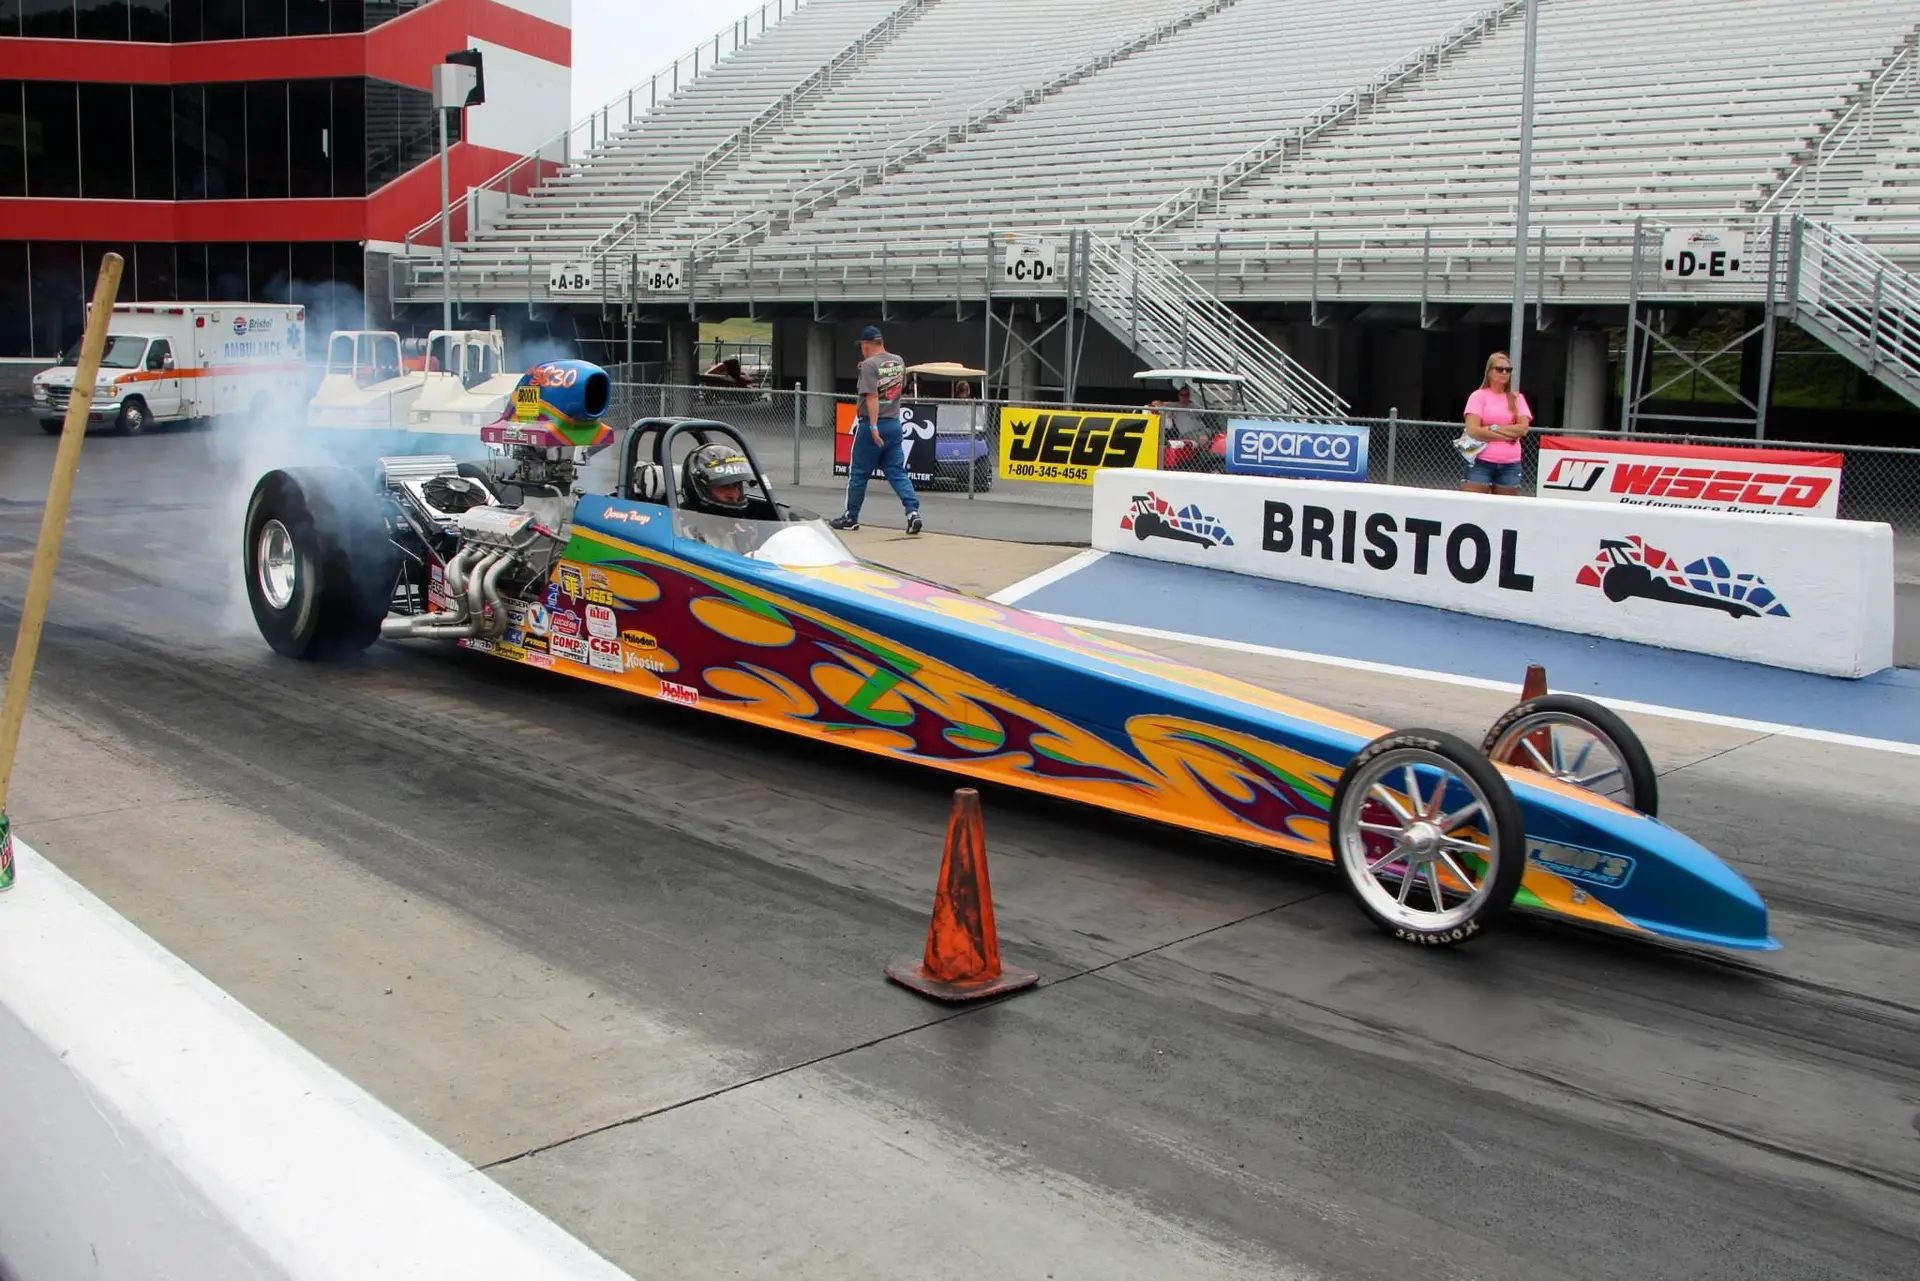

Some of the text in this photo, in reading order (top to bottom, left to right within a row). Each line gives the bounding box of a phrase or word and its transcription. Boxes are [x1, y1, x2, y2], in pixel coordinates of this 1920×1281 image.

[224, 341, 282, 358] AMBULANCE
[1009, 414, 1149, 468] JEGS
[1240, 431, 1350, 464] sparco
[835, 465, 847, 474] THE
[1008, 463, 1088, 480] 1-800-345-4545
[1261, 499, 1534, 592] BRISTOL
[586, 587, 614, 606] JEGS
[553, 634, 581, 651] COMP
[590, 637, 621, 657] CSR
[623, 631, 656, 648] Milodon
[625, 651, 665, 673] Hoosier
[661, 681, 698, 704] Holley
